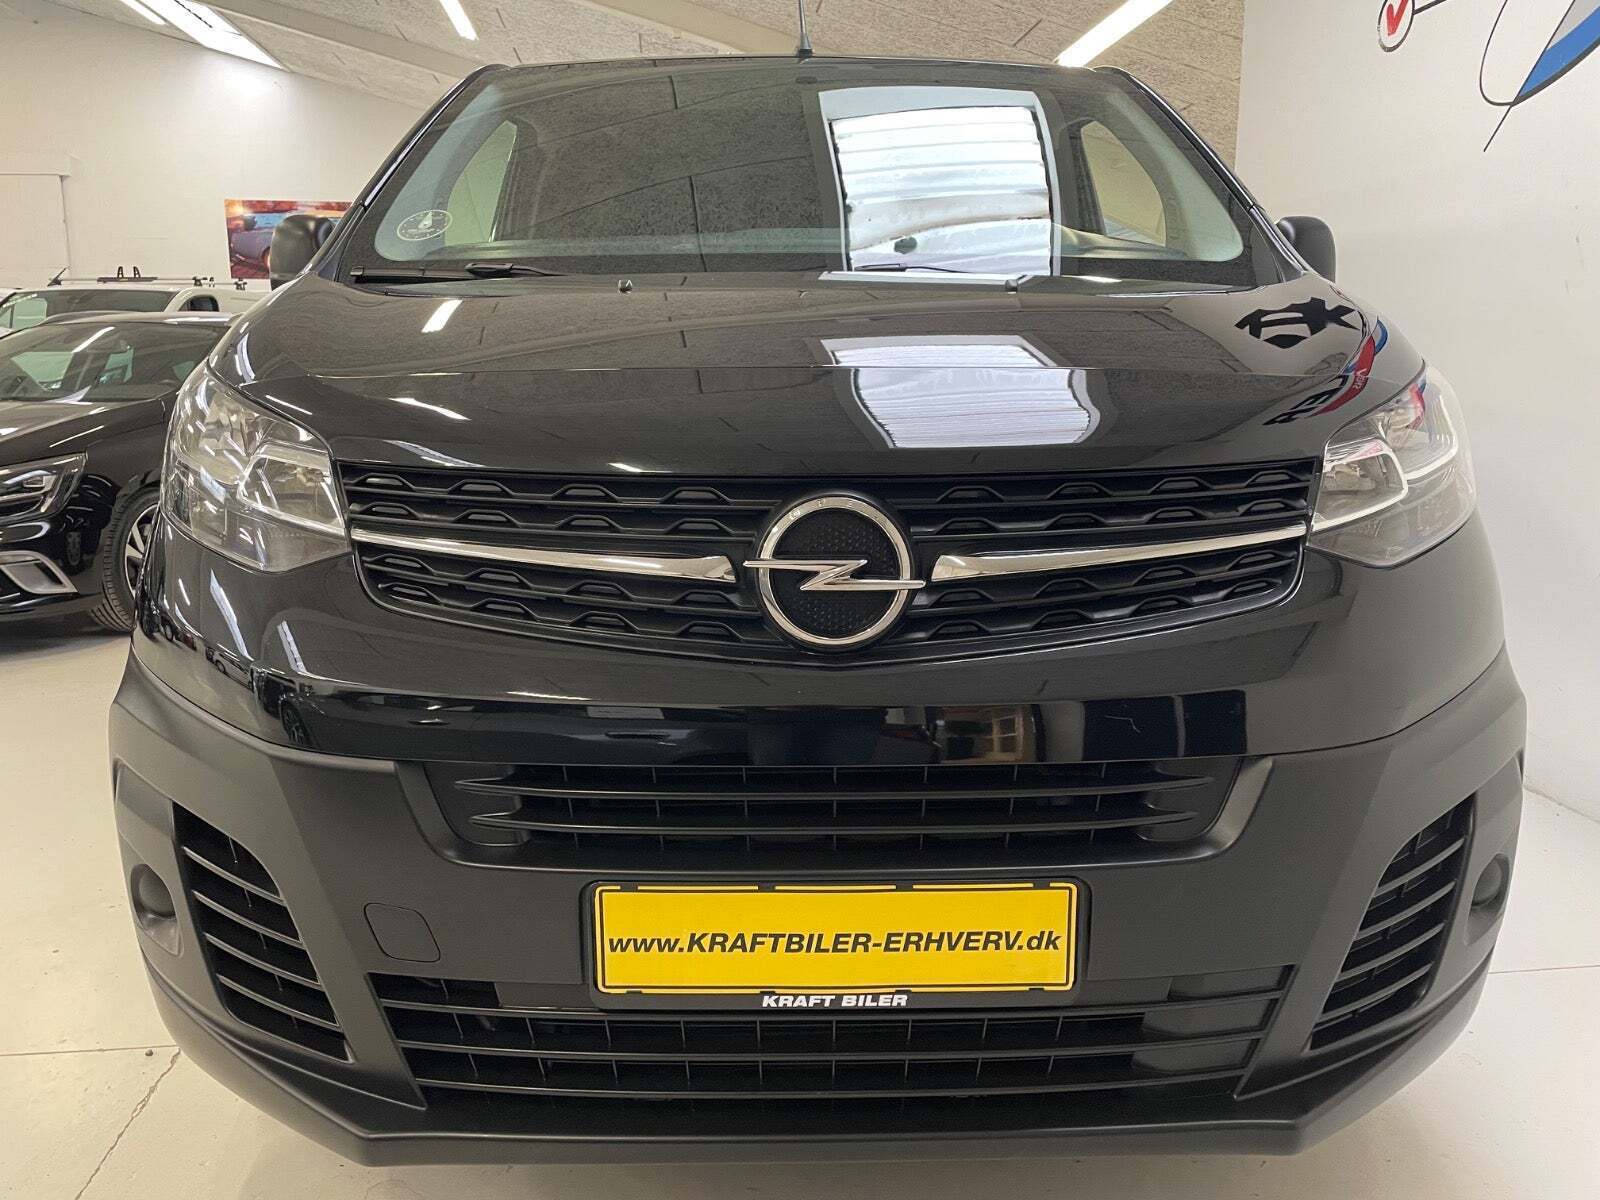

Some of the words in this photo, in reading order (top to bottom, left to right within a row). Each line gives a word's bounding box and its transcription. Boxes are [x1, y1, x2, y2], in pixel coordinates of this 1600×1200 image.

[608, 930, 1061, 953] www.KRAFTBILER-ERHVERV.dk
[762, 995, 836, 1007] KRAFT
[841, 994, 908, 1007] BILER
